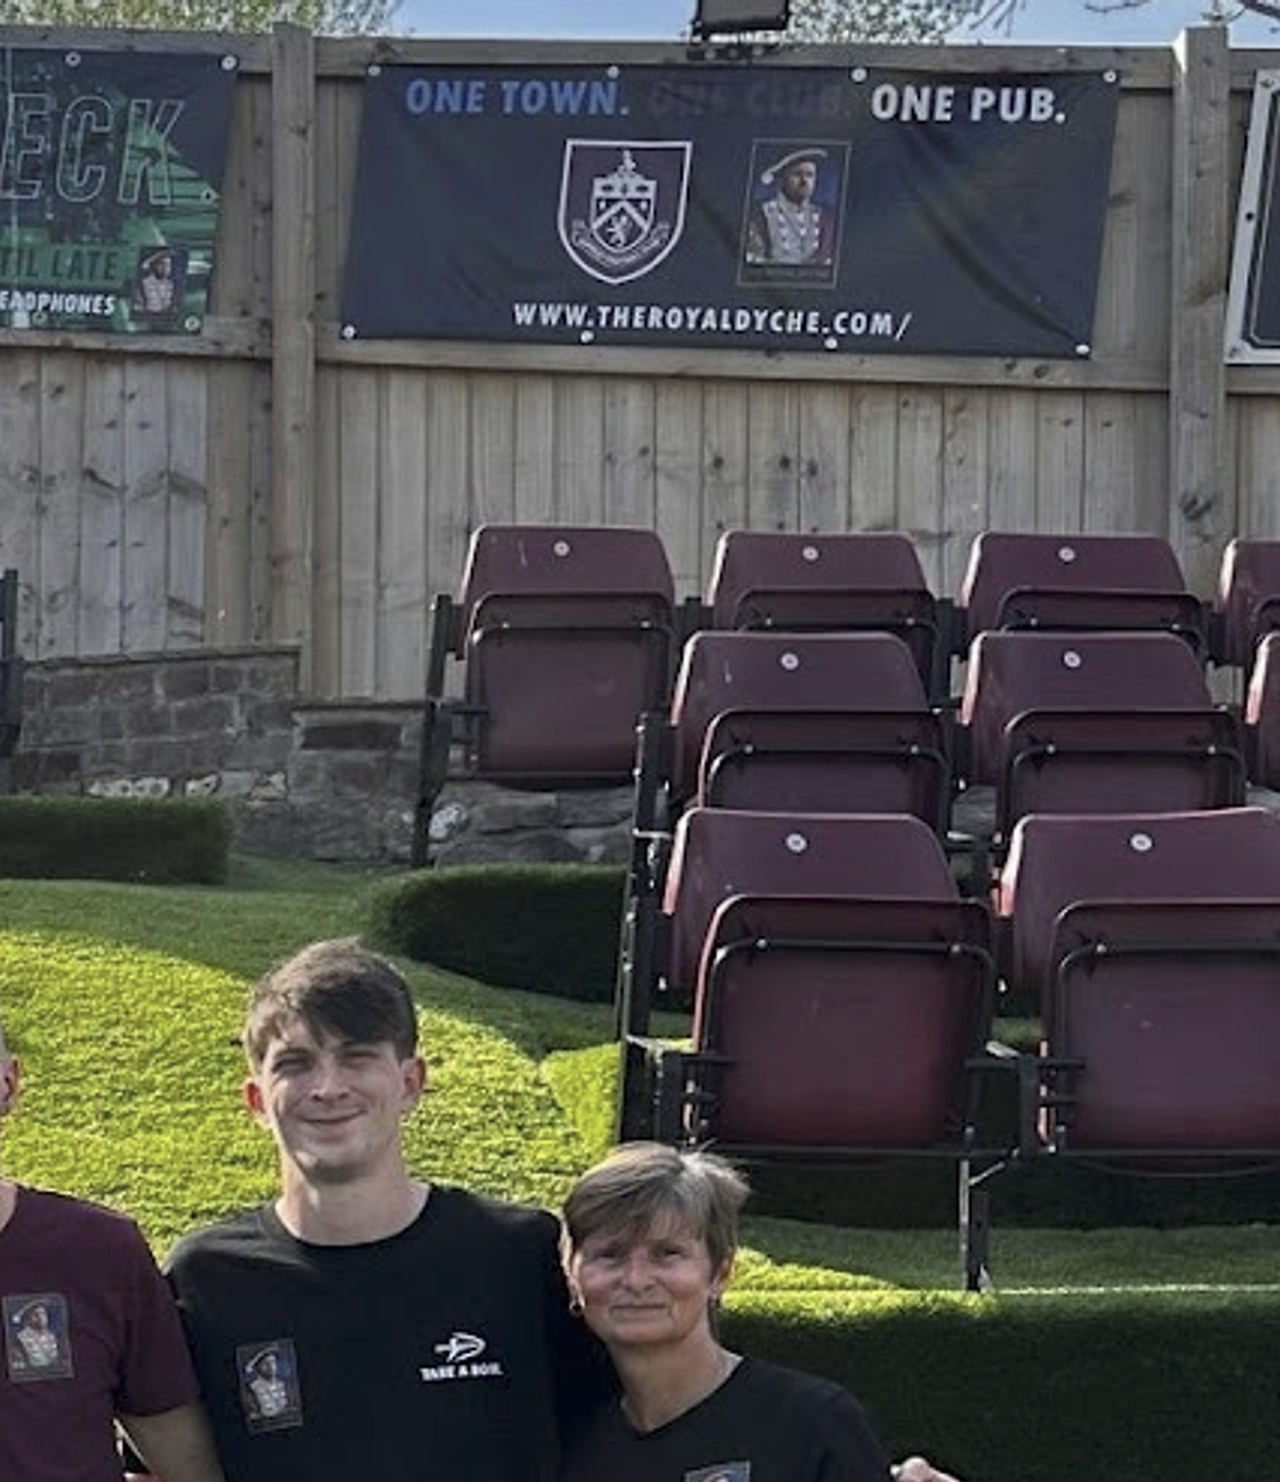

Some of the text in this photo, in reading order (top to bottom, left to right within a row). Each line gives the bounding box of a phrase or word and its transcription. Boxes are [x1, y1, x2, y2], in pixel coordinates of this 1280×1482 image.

[405, 79, 487, 115] ONE
[499, 79, 630, 116] TOWN.
[870, 83, 957, 122] ONE
[968, 85, 1067, 124] PUB.
[50, 247, 121, 281] LATE
[513, 302, 913, 341] WWW.THEROYALDYCHE.COM/
